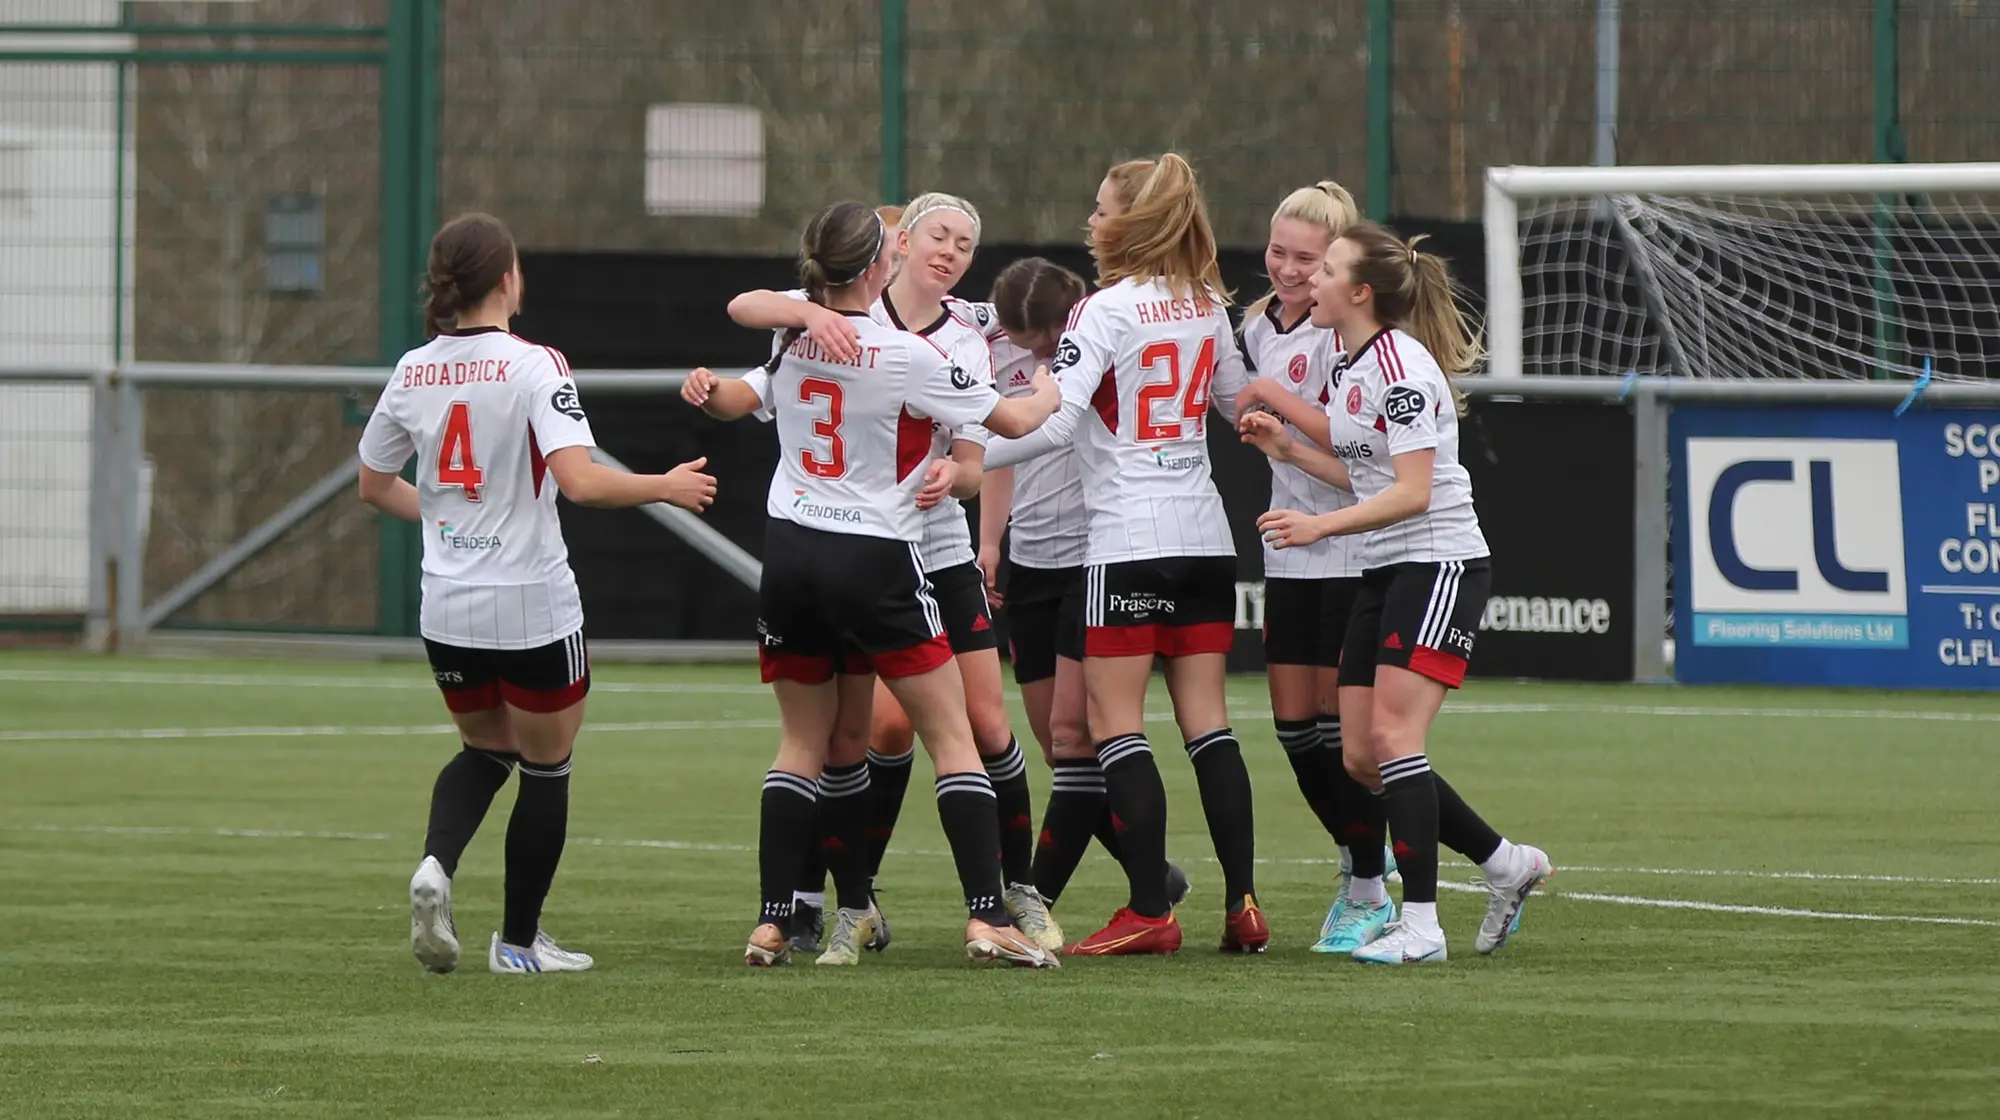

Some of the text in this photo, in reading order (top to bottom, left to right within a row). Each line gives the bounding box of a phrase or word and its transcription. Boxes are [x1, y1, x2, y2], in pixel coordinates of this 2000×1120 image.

[1136, 296, 1215, 324] HANSSE
[403, 360, 512, 389] BROADRICK
[1136, 335, 1215, 443] 24
[799, 375, 847, 481] 3
[436, 401, 484, 503] 4
[801, 504, 862, 523] TENDEKA
[1707, 459, 1890, 593] CL
[1967, 502, 2000, 537] FL
[447, 535, 502, 549] TENDEKA
[1109, 594, 1175, 613] Frasers
[1708, 619, 1894, 643] Flooring Solutions Ltd
[1938, 637, 2000, 667] CLFL
